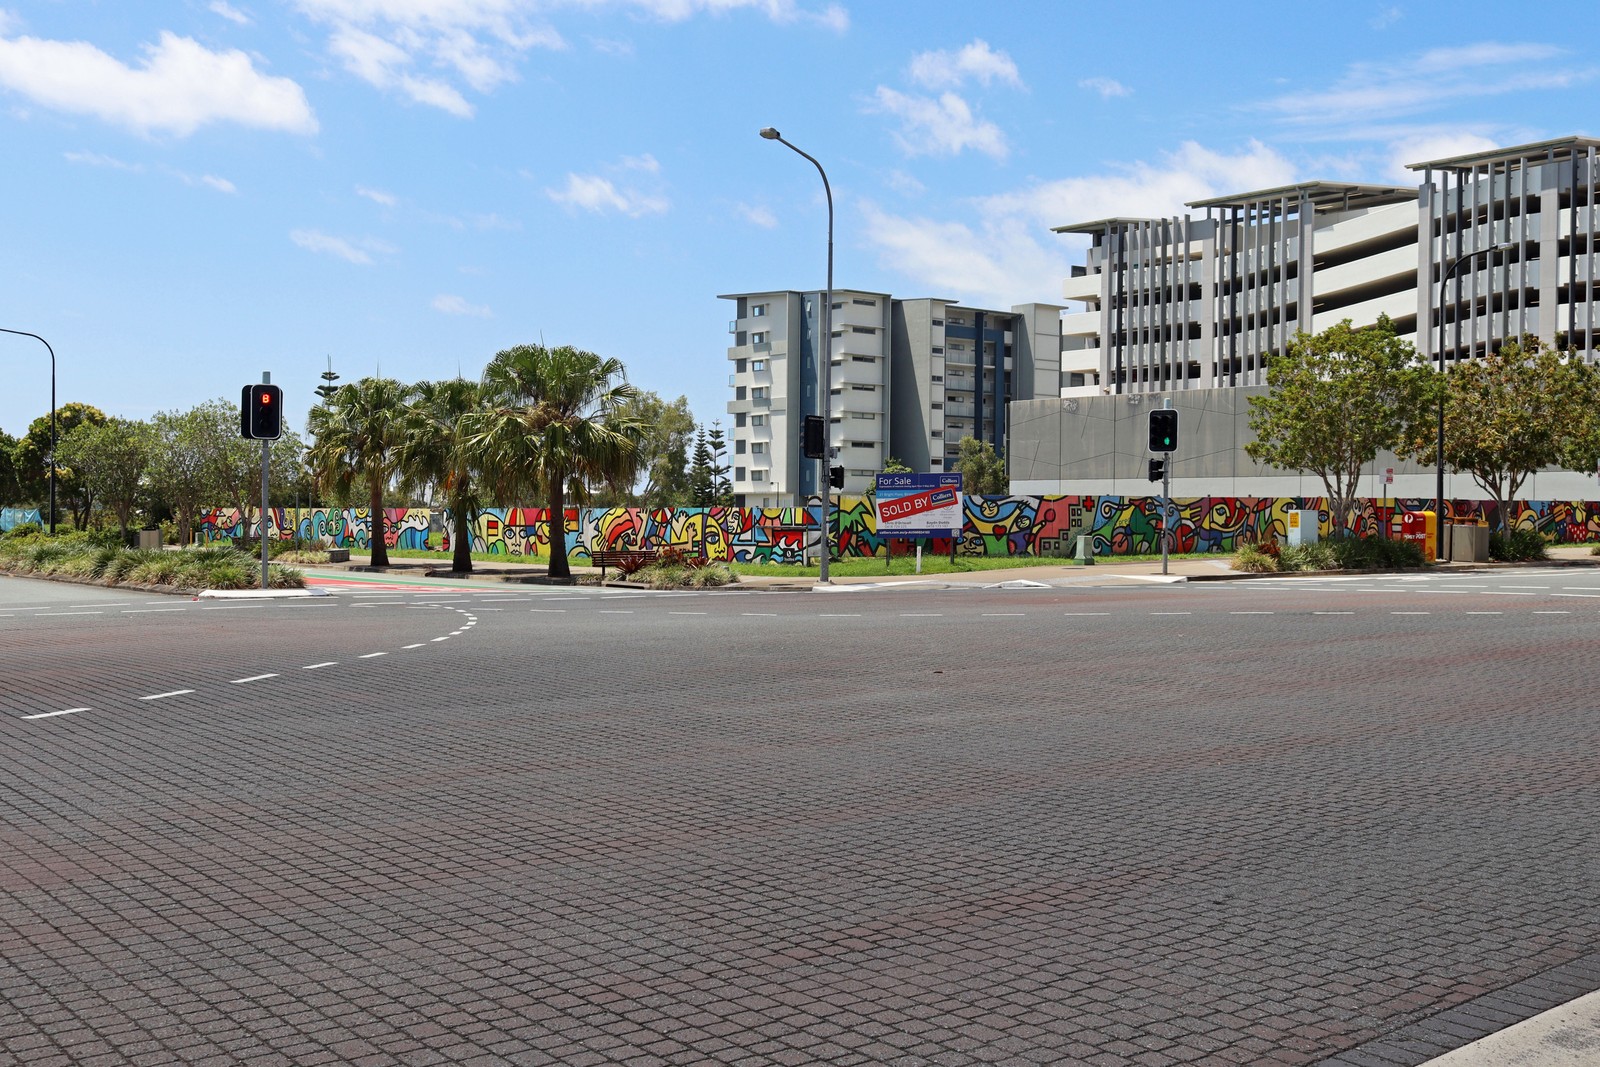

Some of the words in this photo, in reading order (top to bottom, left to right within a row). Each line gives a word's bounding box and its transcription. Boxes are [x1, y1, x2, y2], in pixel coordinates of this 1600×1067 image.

[894, 477, 911, 485] Sale
[882, 501, 911, 517] SOLD
[914, 497, 928, 508] BY
